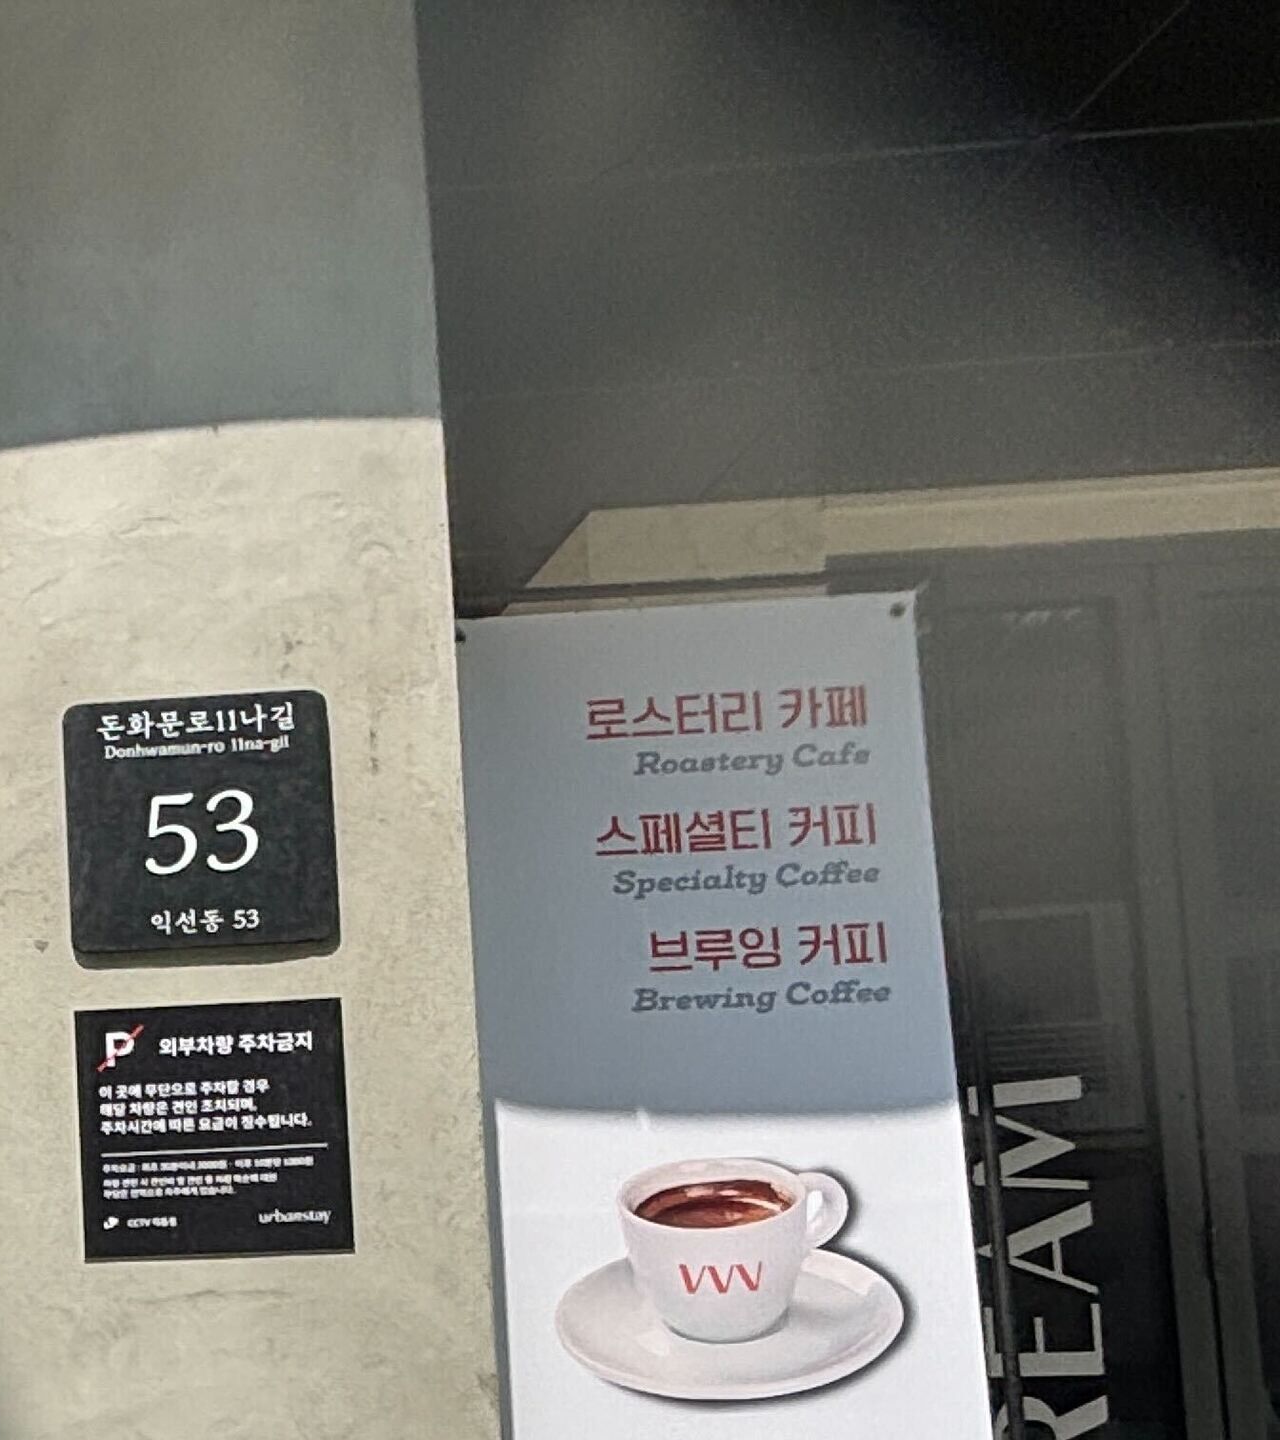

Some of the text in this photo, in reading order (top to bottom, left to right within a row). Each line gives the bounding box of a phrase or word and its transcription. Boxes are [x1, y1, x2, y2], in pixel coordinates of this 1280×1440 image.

[96, 701, 295, 741] 돈화문로11나길
[586, 684, 868, 740] 로스터리 카페
[104, 742, 225, 760] Donhwamun-ro
[633, 741, 871, 776] Roastery Cafe
[144, 789, 259, 875] 53
[595, 802, 877, 857] 스페셜티 커피
[613, 859, 880, 900] Specialty Coffee
[150, 908, 260, 935] 익선동 53
[649, 921, 888, 973] 브루잉 커피
[631, 979, 892, 1014] Brewing Coffee
[158, 1030, 313, 1058] 외부차량 주차금지
[98, 1085, 113, 1101] 이
[257, 1209, 332, 1225] urbanstay
